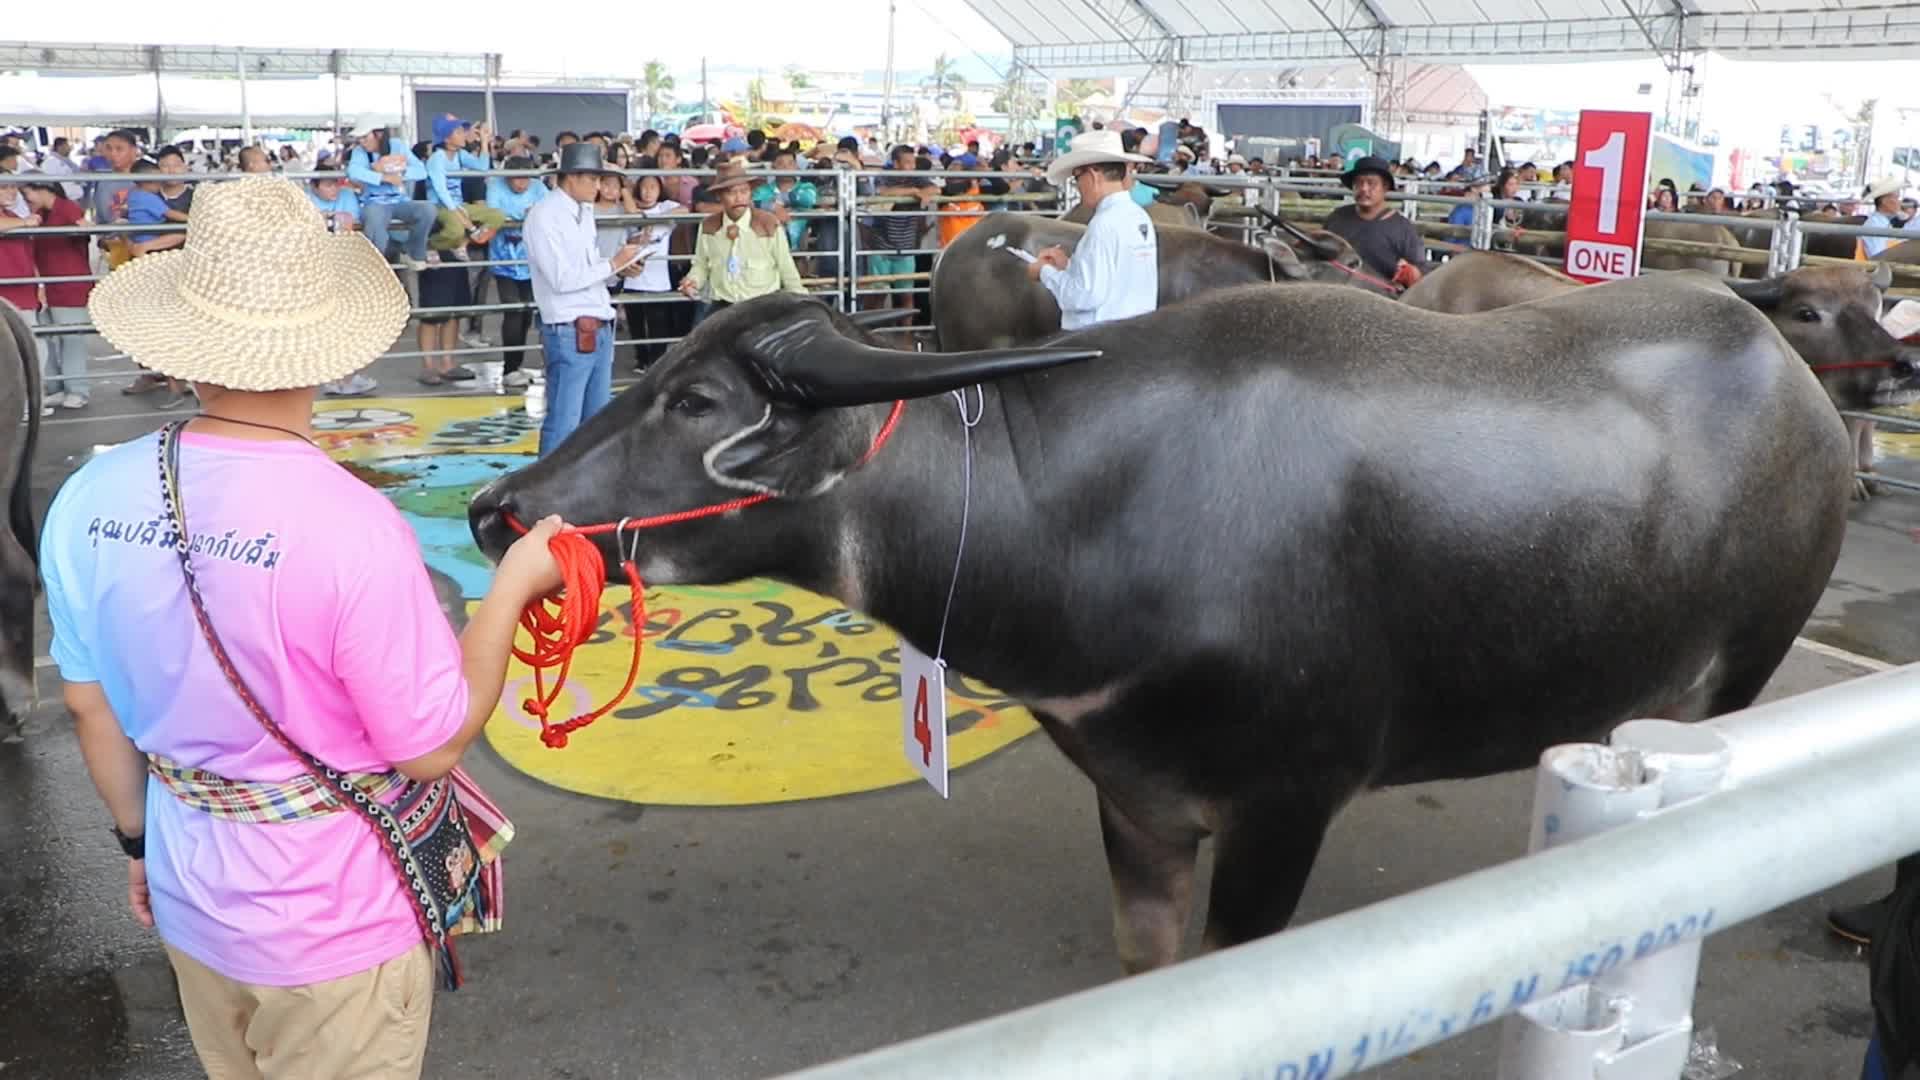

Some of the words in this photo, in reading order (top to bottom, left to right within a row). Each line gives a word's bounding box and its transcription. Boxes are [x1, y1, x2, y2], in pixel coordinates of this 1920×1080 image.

[1584, 131, 1626, 235] 1
[1575, 248, 1625, 275] ONE
[914, 674, 932, 768] 4
